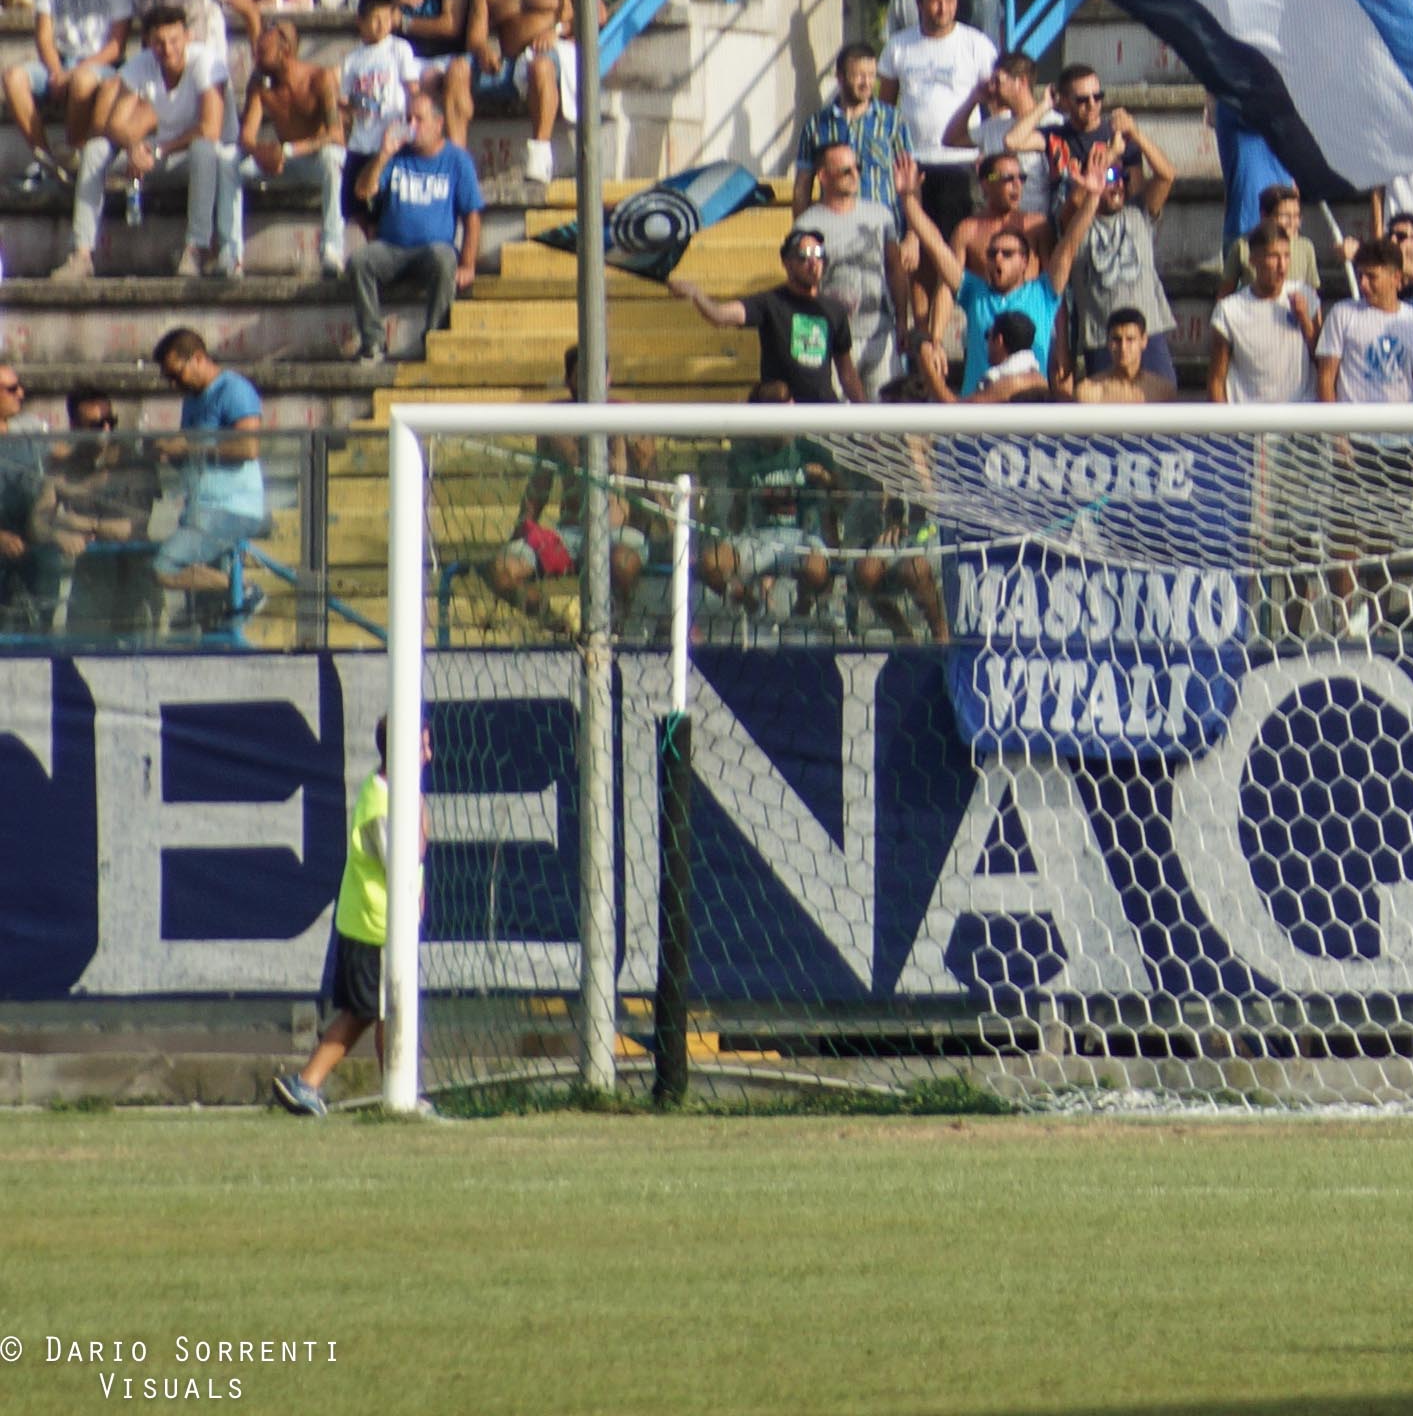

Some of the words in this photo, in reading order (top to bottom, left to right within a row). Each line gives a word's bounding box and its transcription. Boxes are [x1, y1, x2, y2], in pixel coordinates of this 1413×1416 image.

[985, 442, 1195, 500] ONORE
[955, 562, 1240, 645] MASSIMO
[984, 655, 1191, 735] VITALI
